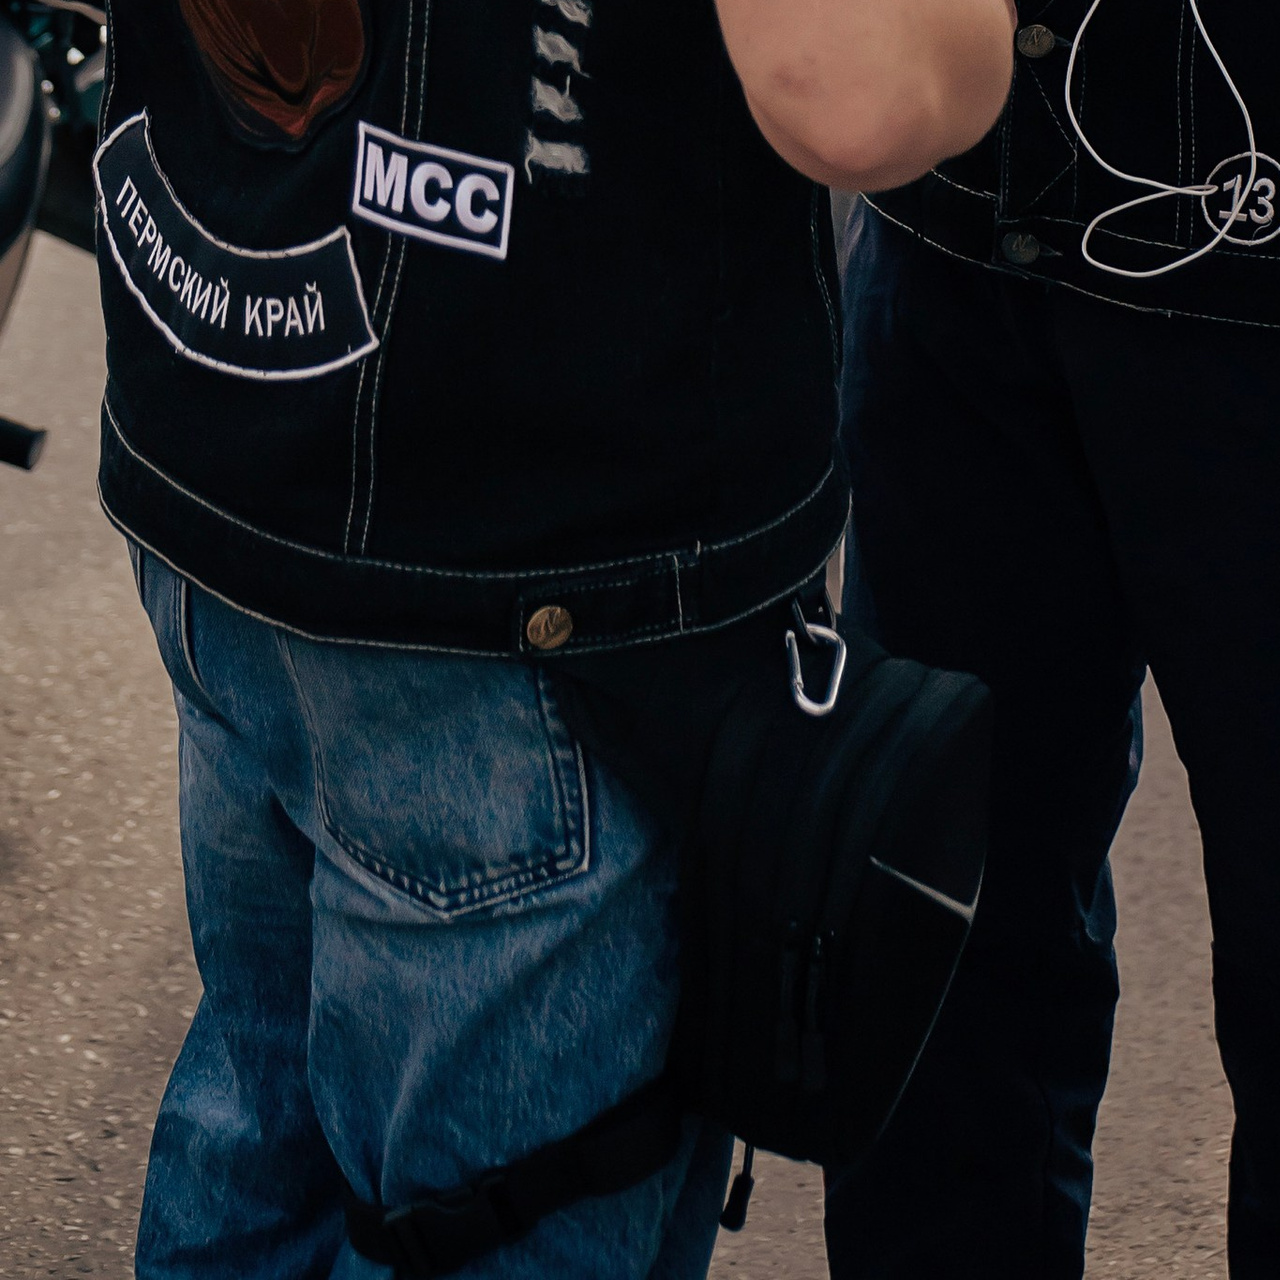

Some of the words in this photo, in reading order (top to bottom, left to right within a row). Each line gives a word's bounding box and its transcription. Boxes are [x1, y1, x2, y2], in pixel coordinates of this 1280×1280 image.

[363, 142, 501, 233] MCC
[1218, 174, 1276, 224] 13
[115, 175, 231, 329] ПЕРМСКИЙ
[244, 281, 325, 337] КРАЙ
